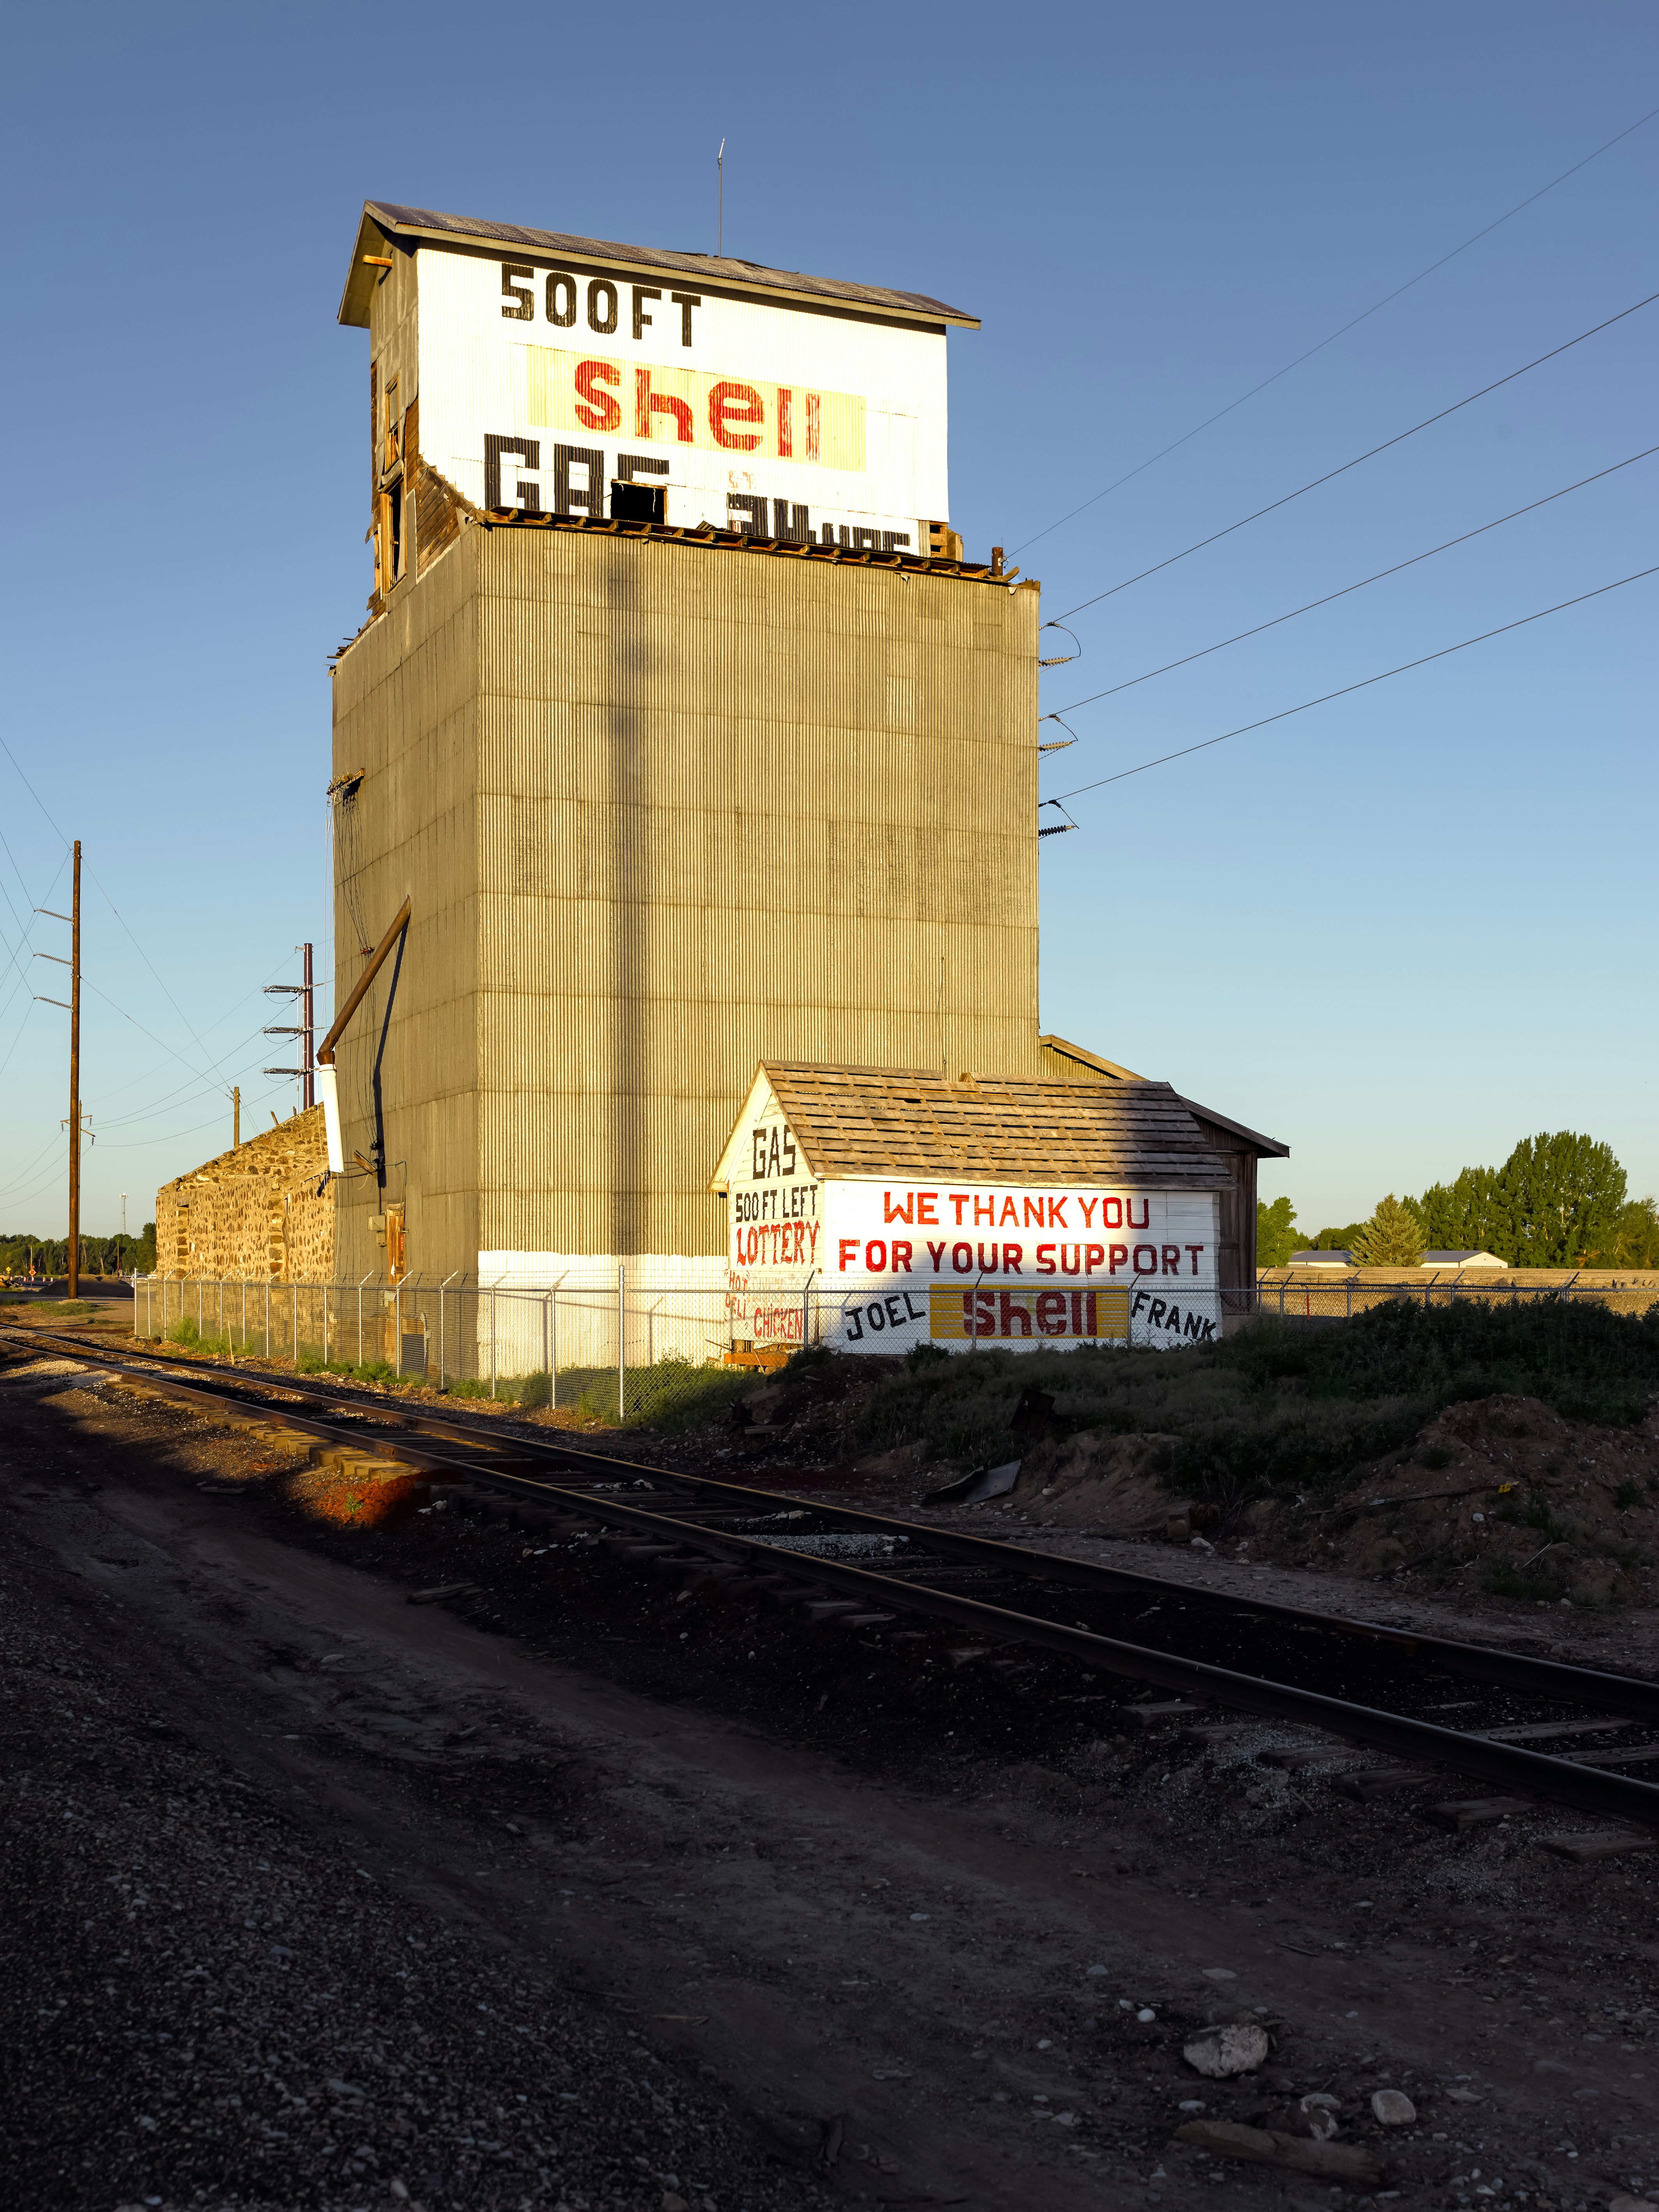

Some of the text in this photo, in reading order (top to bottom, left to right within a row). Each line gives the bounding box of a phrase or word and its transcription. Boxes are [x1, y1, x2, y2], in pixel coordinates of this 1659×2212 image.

[753, 1125, 796, 1180] GAS
[736, 1184, 818, 1223] 500 FT LEFT
[884, 1192, 1149, 1229] WE THANK YOU
[737, 1220, 820, 1268] LOTTERY
[839, 1239, 1204, 1275] FOR YOUR SUPPORT
[845, 1292, 926, 1341] JOEL
[1132, 1291, 1216, 1339] FRANK
